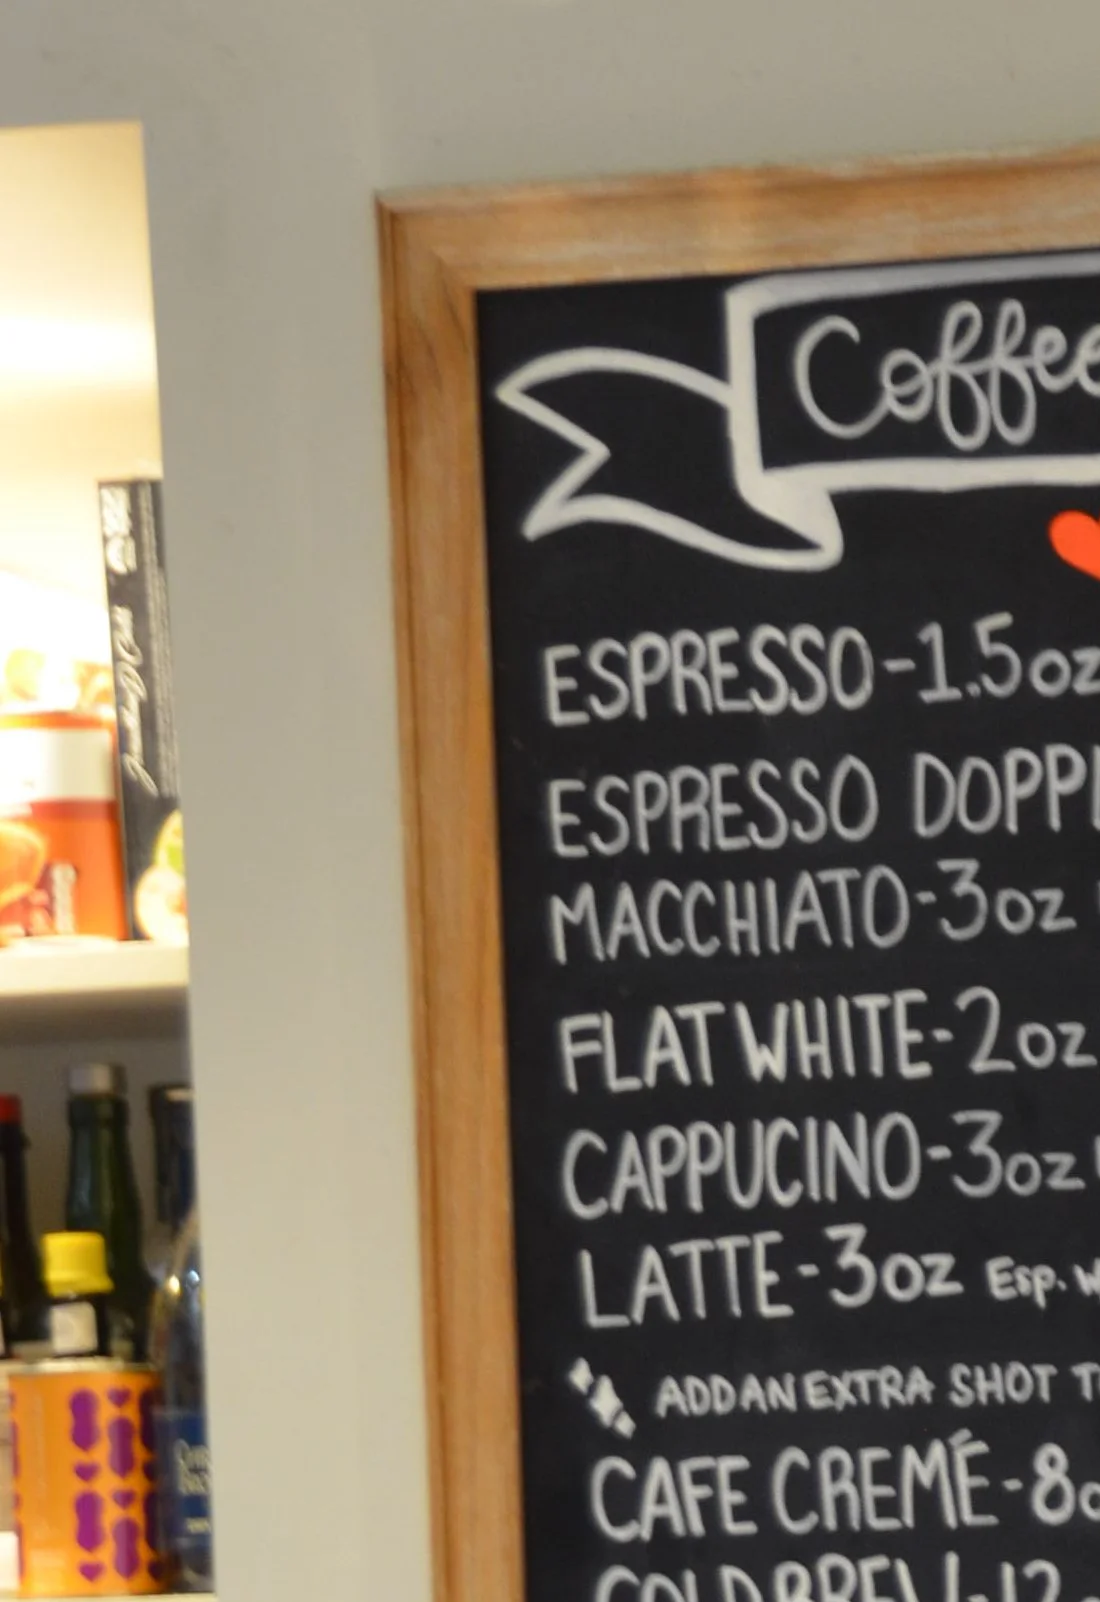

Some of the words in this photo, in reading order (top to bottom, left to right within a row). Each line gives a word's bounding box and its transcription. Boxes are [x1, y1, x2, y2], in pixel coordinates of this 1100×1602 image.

[544, 623, 874, 727] ESPRESSO
[547, 754, 879, 858] ESPRESSO
[550, 864, 910, 965] MACCHIATO
[559, 1002, 725, 1094] FLAT
[562, 1111, 921, 1220] CAPPUCINO
[581, 1230, 794, 1328] LATTE
[656, 1375, 738, 1419] ADD
[806, 1365, 937, 1409] EXTRA
[949, 1360, 1058, 1407] SHOT
[591, 1455, 758, 1542] CAFE
